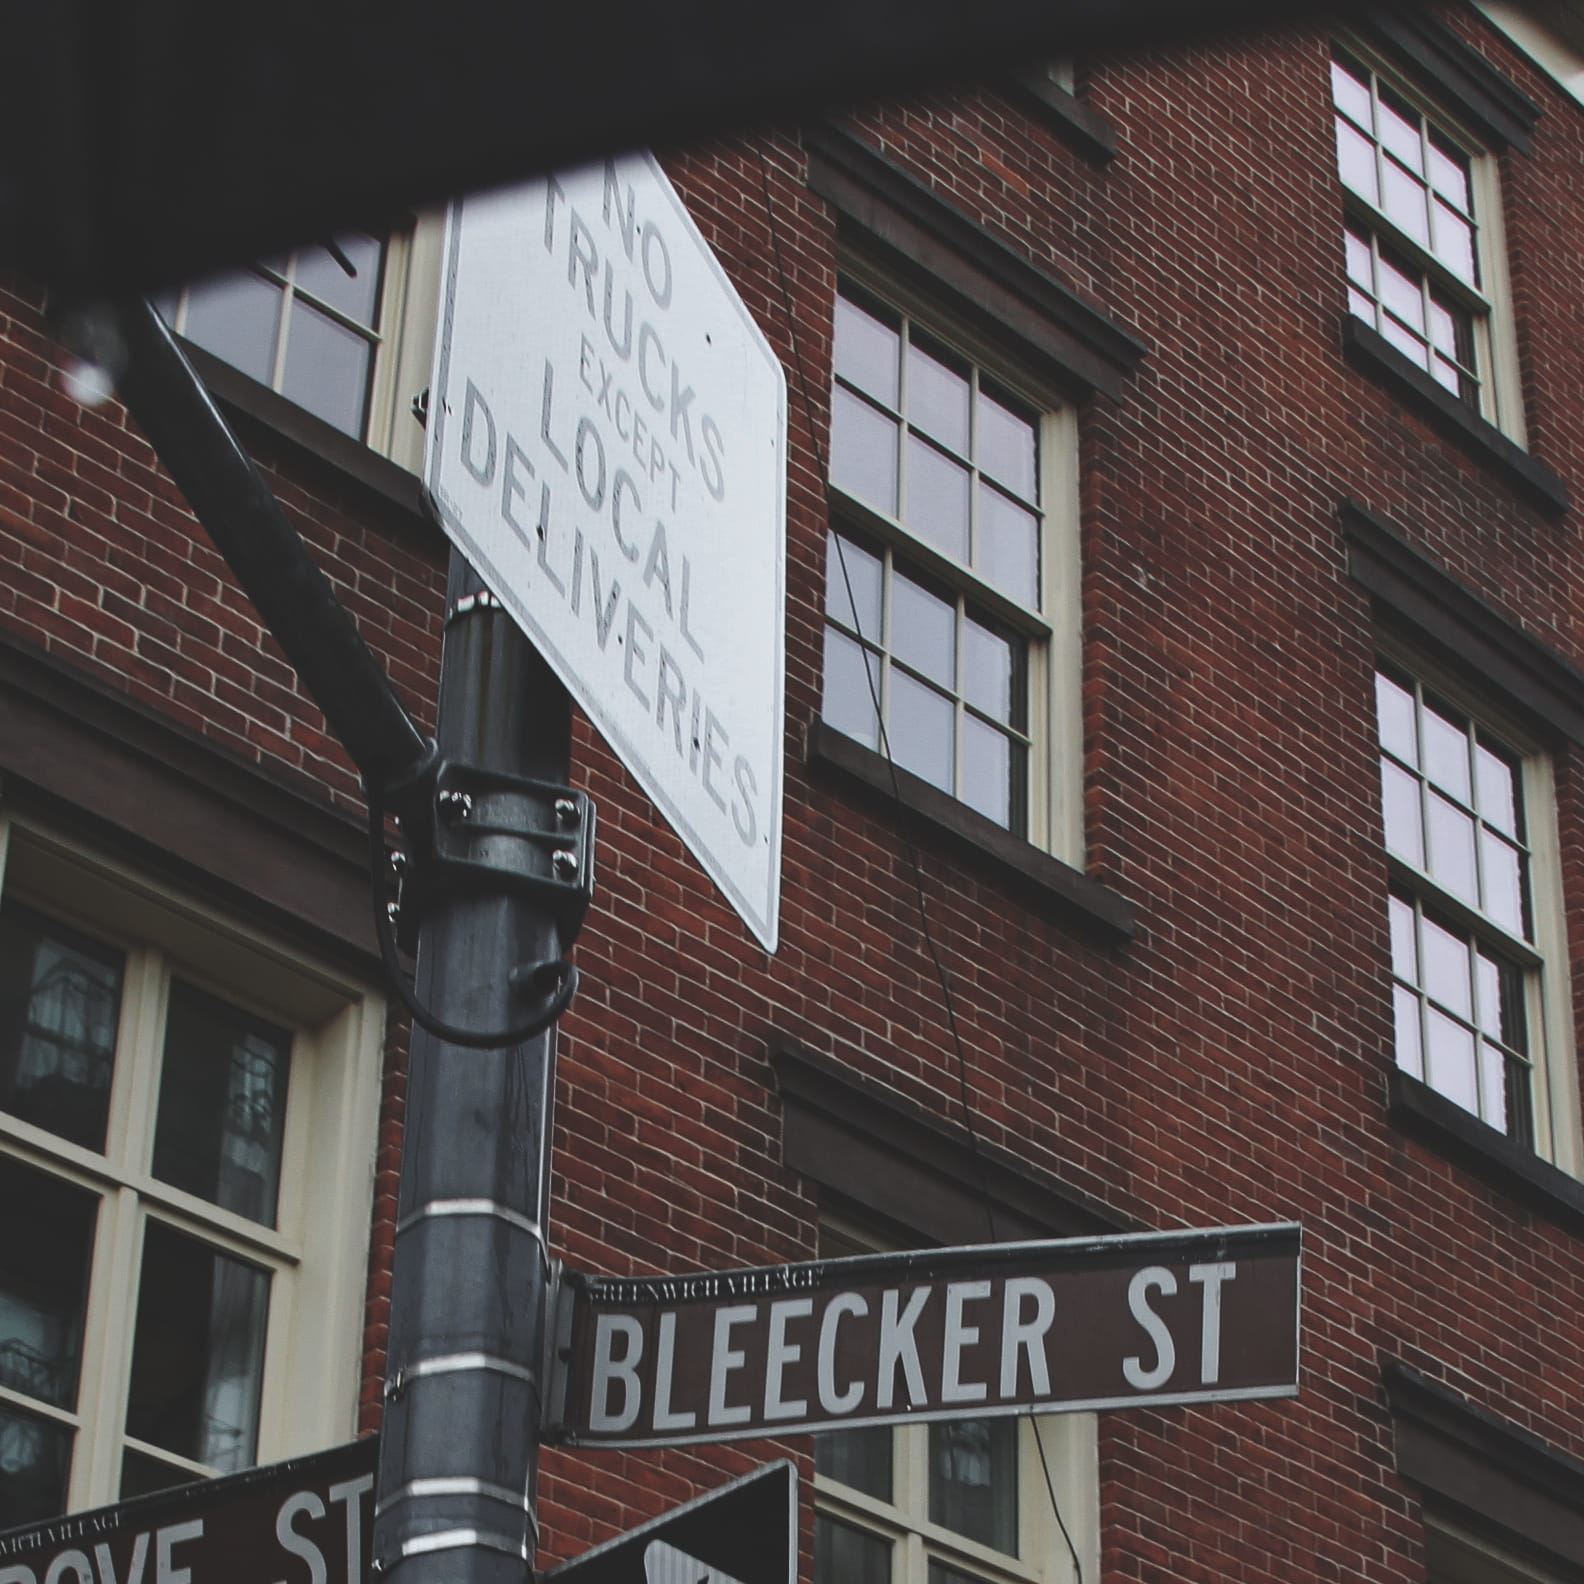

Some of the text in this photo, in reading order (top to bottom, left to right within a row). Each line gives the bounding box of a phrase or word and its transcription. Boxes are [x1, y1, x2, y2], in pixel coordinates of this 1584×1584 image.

[544, 174, 726, 502] TRUCKS
[603, 158, 674, 311] NO
[540, 358, 706, 664] LOCAL
[579, 332, 682, 514] EXCEPT
[460, 375, 758, 849] DELIVERIES
[587, 1261, 1238, 1434] BLEECKER ST
